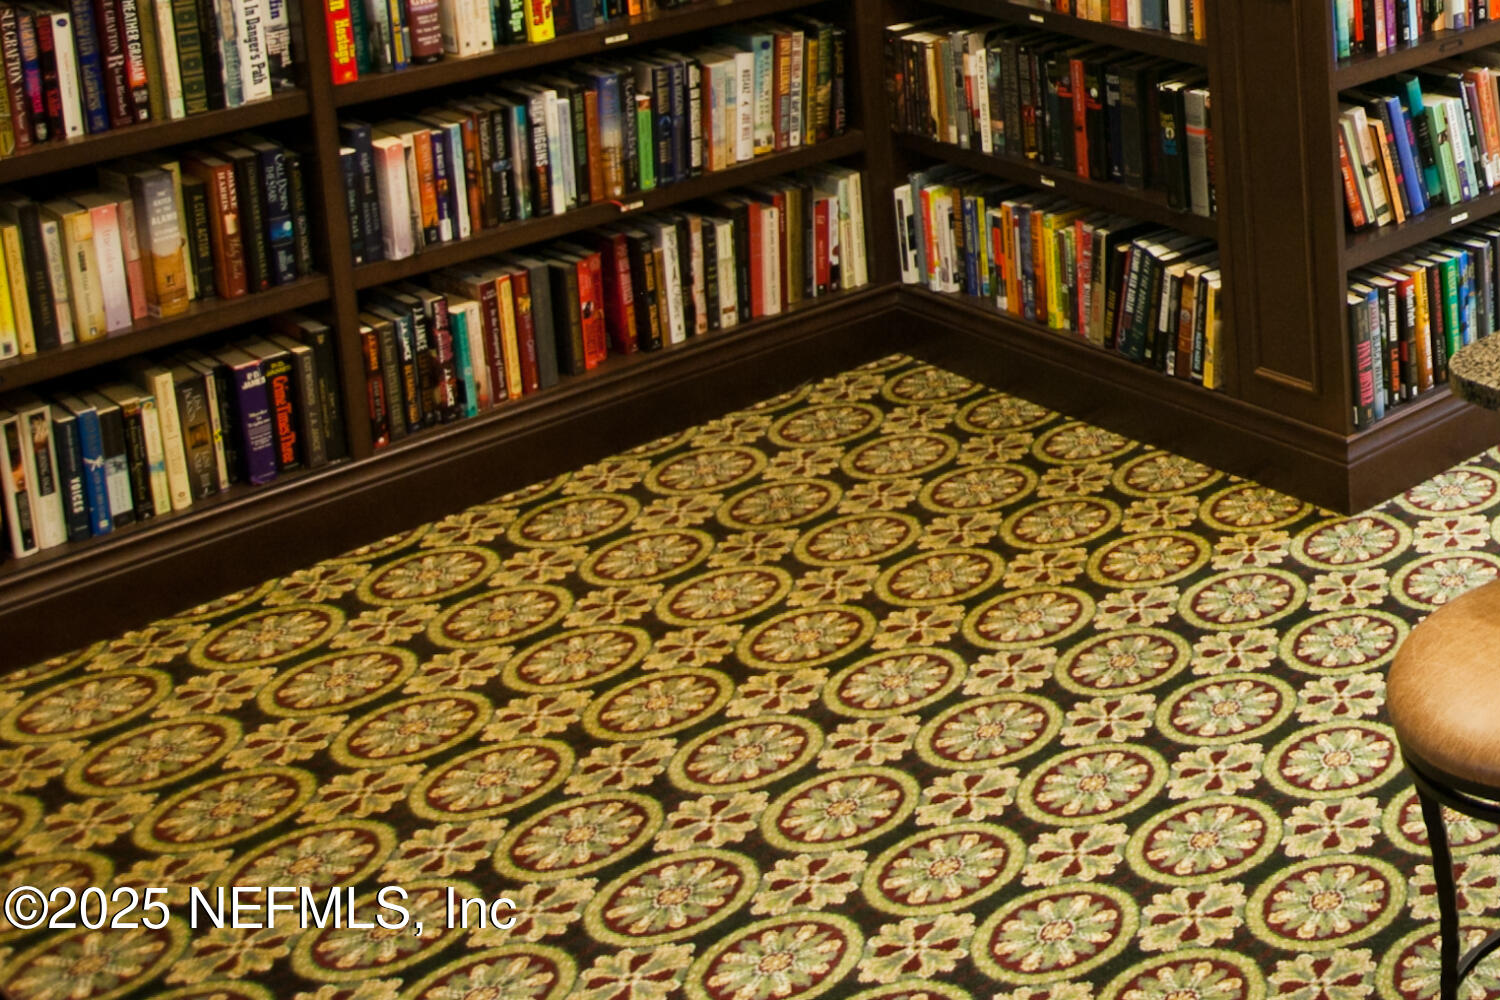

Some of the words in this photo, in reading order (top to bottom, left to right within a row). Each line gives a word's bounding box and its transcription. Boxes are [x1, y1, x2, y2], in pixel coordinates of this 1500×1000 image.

[1, 8, 16, 31] SUE
[121, 0, 137, 41] HEATHER
[246, 4, 258, 16] In
[510, 11, 525, 32] Ops
[243, 18, 264, 61] Danger's
[334, 18, 352, 64] Hostage
[1, 31, 23, 85] GRAFTON
[128, 42, 143, 80] GRAHAM
[251, 63, 266, 85] Path
[531, 98, 545, 123] JACK
[479, 117, 492, 160] Headcase
[533, 125, 548, 167] HIGGINS
[273, 153, 288, 178] CALL
[217, 171, 230, 212] HARRIS
[226, 169, 239, 209] JOANNE
[277, 179, 290, 211] DOWN
[193, 202, 206, 225] CIVIL
[196, 226, 210, 258] ACTION
[1369, 300, 1380, 331] PARKER
[1387, 293, 1398, 321] JEFFERSON
[1407, 307, 1417, 327] Parker
[415, 324, 429, 352] JANCE
[491, 328, 503, 359] Company
[1389, 321, 1399, 342] PARKER
[1357, 340, 1372, 370] FINAL
[1372, 334, 1384, 364] BLACK
[272, 375, 291, 405] Crime
[1359, 369, 1374, 407] JUSTICE
[1374, 365, 1385, 394] WATER
[1392, 359, 1402, 392] OUTLAWS
[445, 383, 456, 406] JANCE
[276, 403, 295, 434] Times
[279, 431, 297, 463] Three
[70, 476, 85, 514] VOICES
